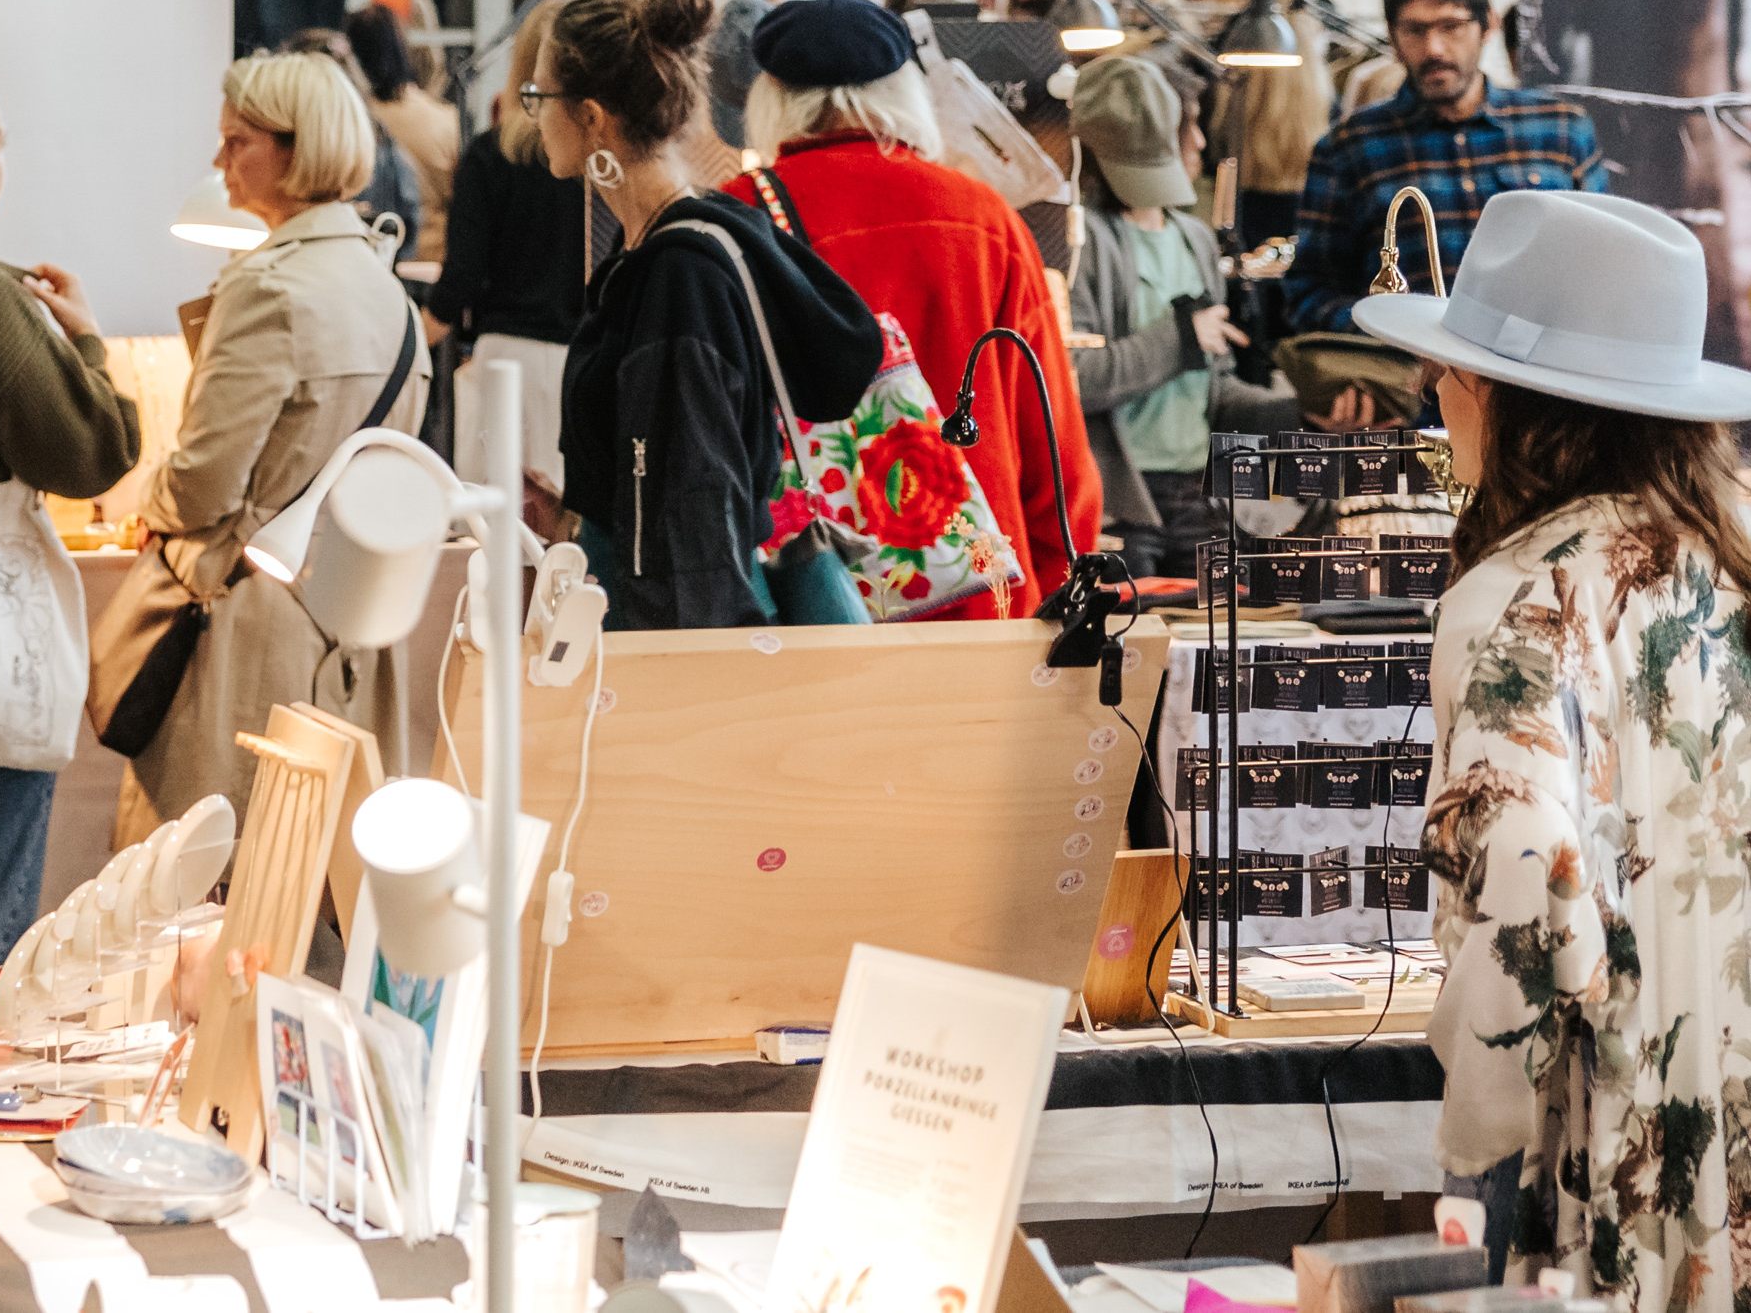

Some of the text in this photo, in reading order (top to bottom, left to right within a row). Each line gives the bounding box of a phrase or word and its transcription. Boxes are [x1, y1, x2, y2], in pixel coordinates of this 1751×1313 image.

[1265, 855, 1292, 868] UNIQUE
[886, 1046, 985, 1083] WORKSHOP
[864, 1070, 998, 1120] PORZELLANRINGE
[890, 1102, 954, 1133] GIESSEN
[544, 1151, 624, 1179] Design: IKEA of Sweden
[649, 1177, 710, 1194] IKEA of Sweden AB
[1238, 1182, 1263, 1190] Sweden
[1305, 1181, 1312, 1189] of
[1340, 1178, 1350, 1186] AB
